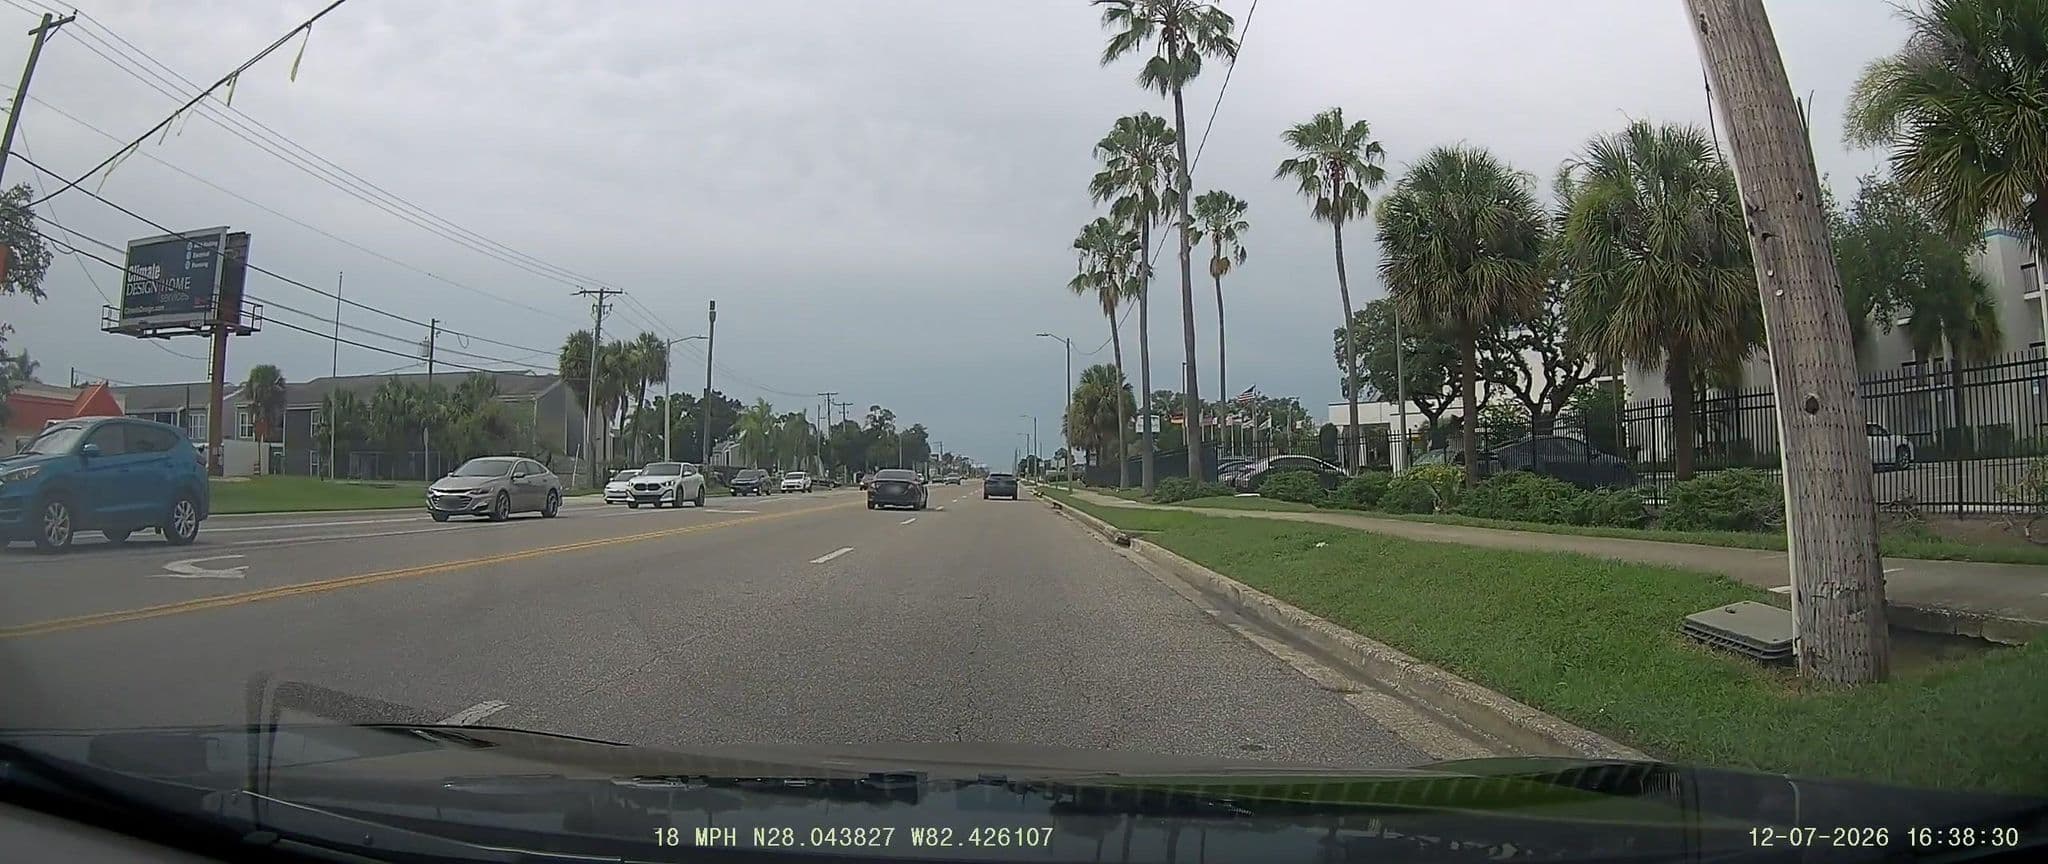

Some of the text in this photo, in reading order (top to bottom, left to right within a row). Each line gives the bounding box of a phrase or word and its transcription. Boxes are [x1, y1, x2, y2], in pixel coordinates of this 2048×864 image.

[127, 263, 161, 282] Climate
[126, 276, 191, 297] DESIGN HOME
